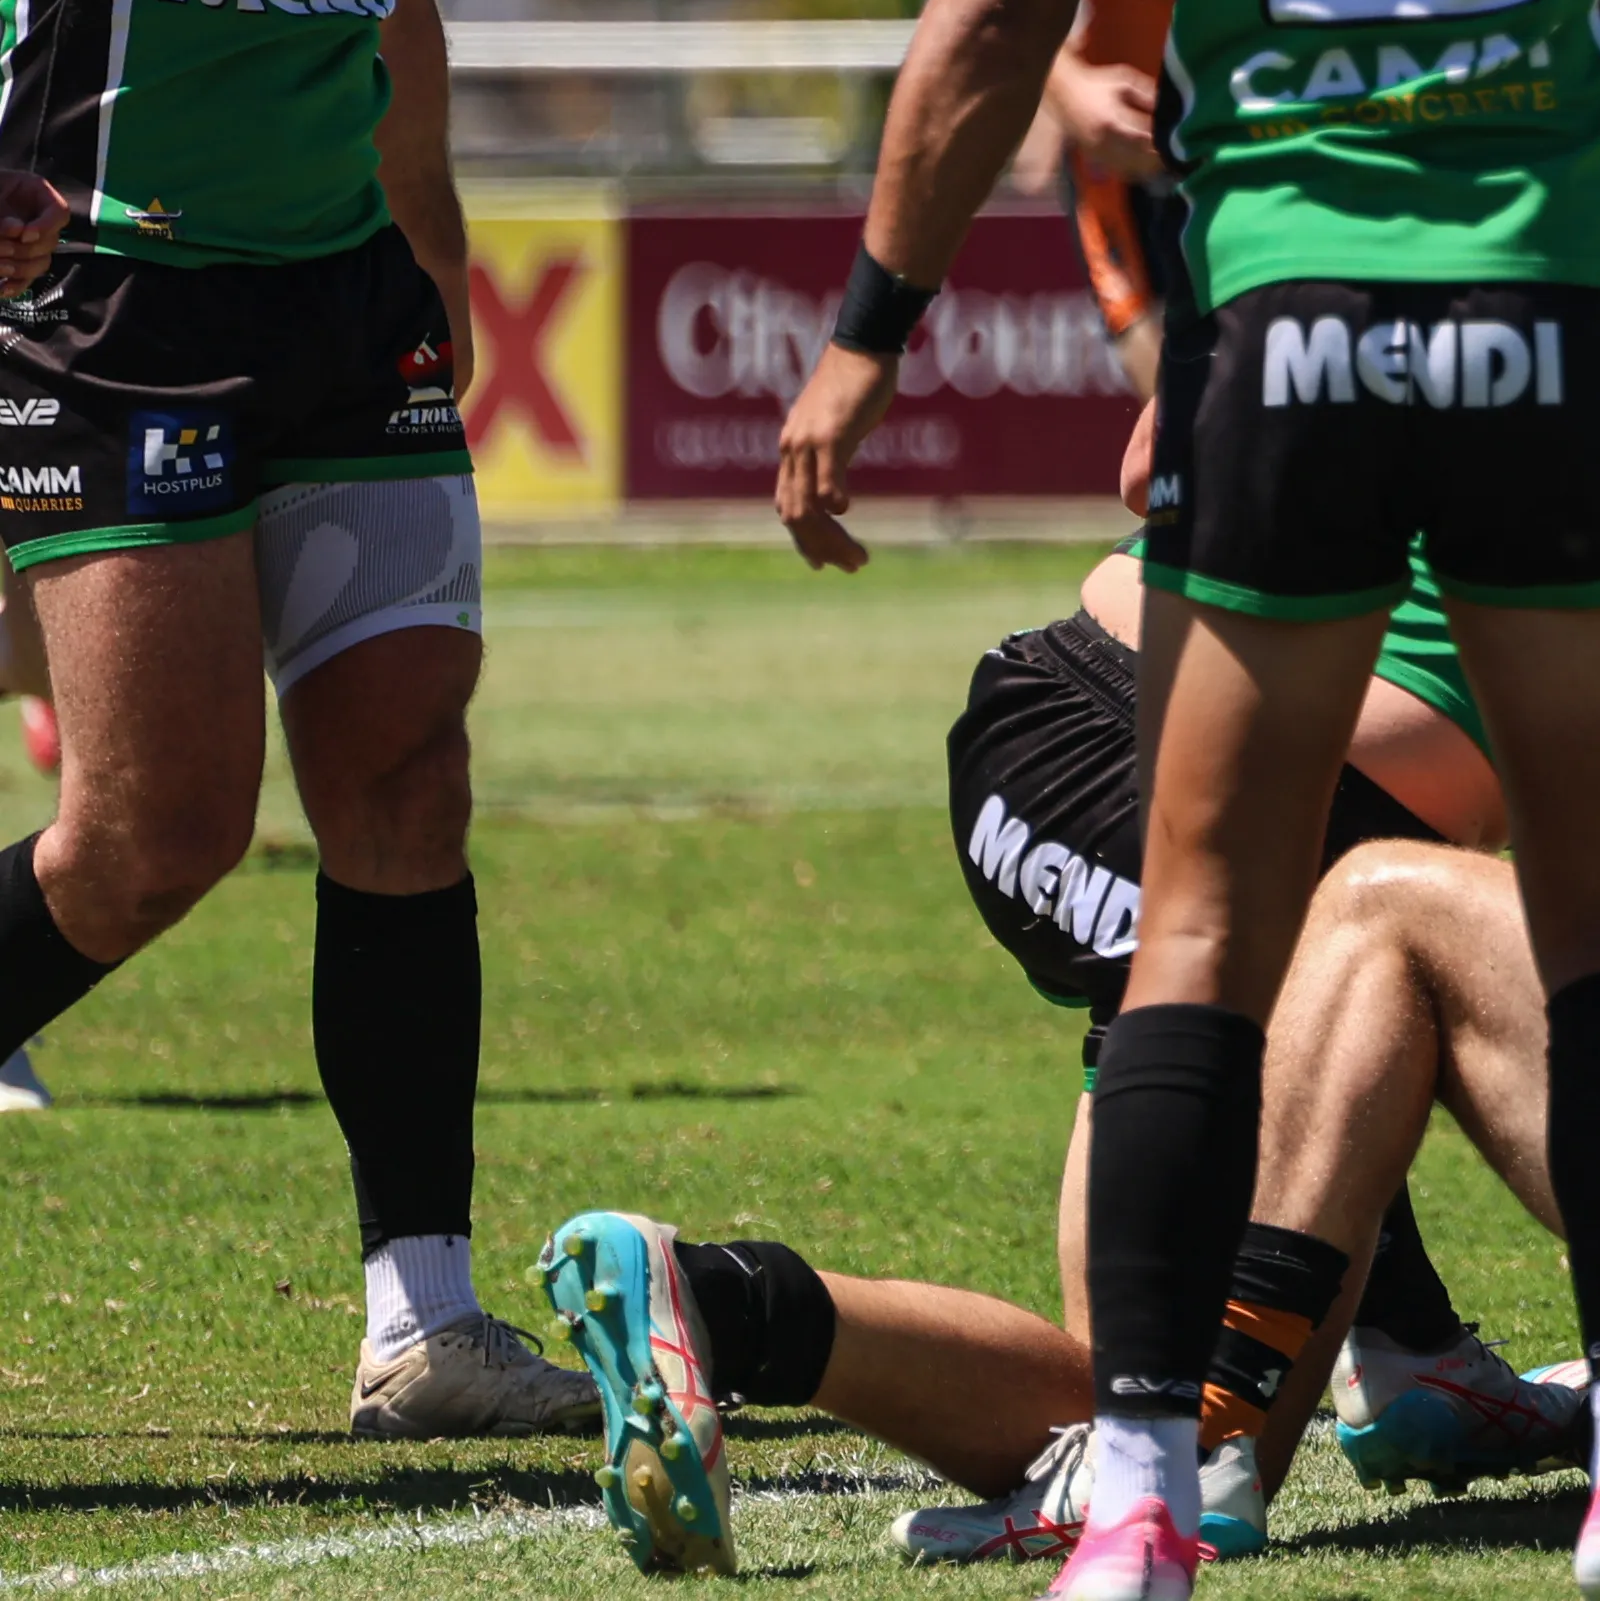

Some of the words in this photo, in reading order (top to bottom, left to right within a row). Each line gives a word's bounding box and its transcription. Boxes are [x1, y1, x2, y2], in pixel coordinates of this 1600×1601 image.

[1262, 314, 1566, 411] MENDI
[385, 424, 463, 435] CONSTRUC
[143, 473, 224, 496] HOSTPLUS
[15, 496, 84, 512] QUARRIES
